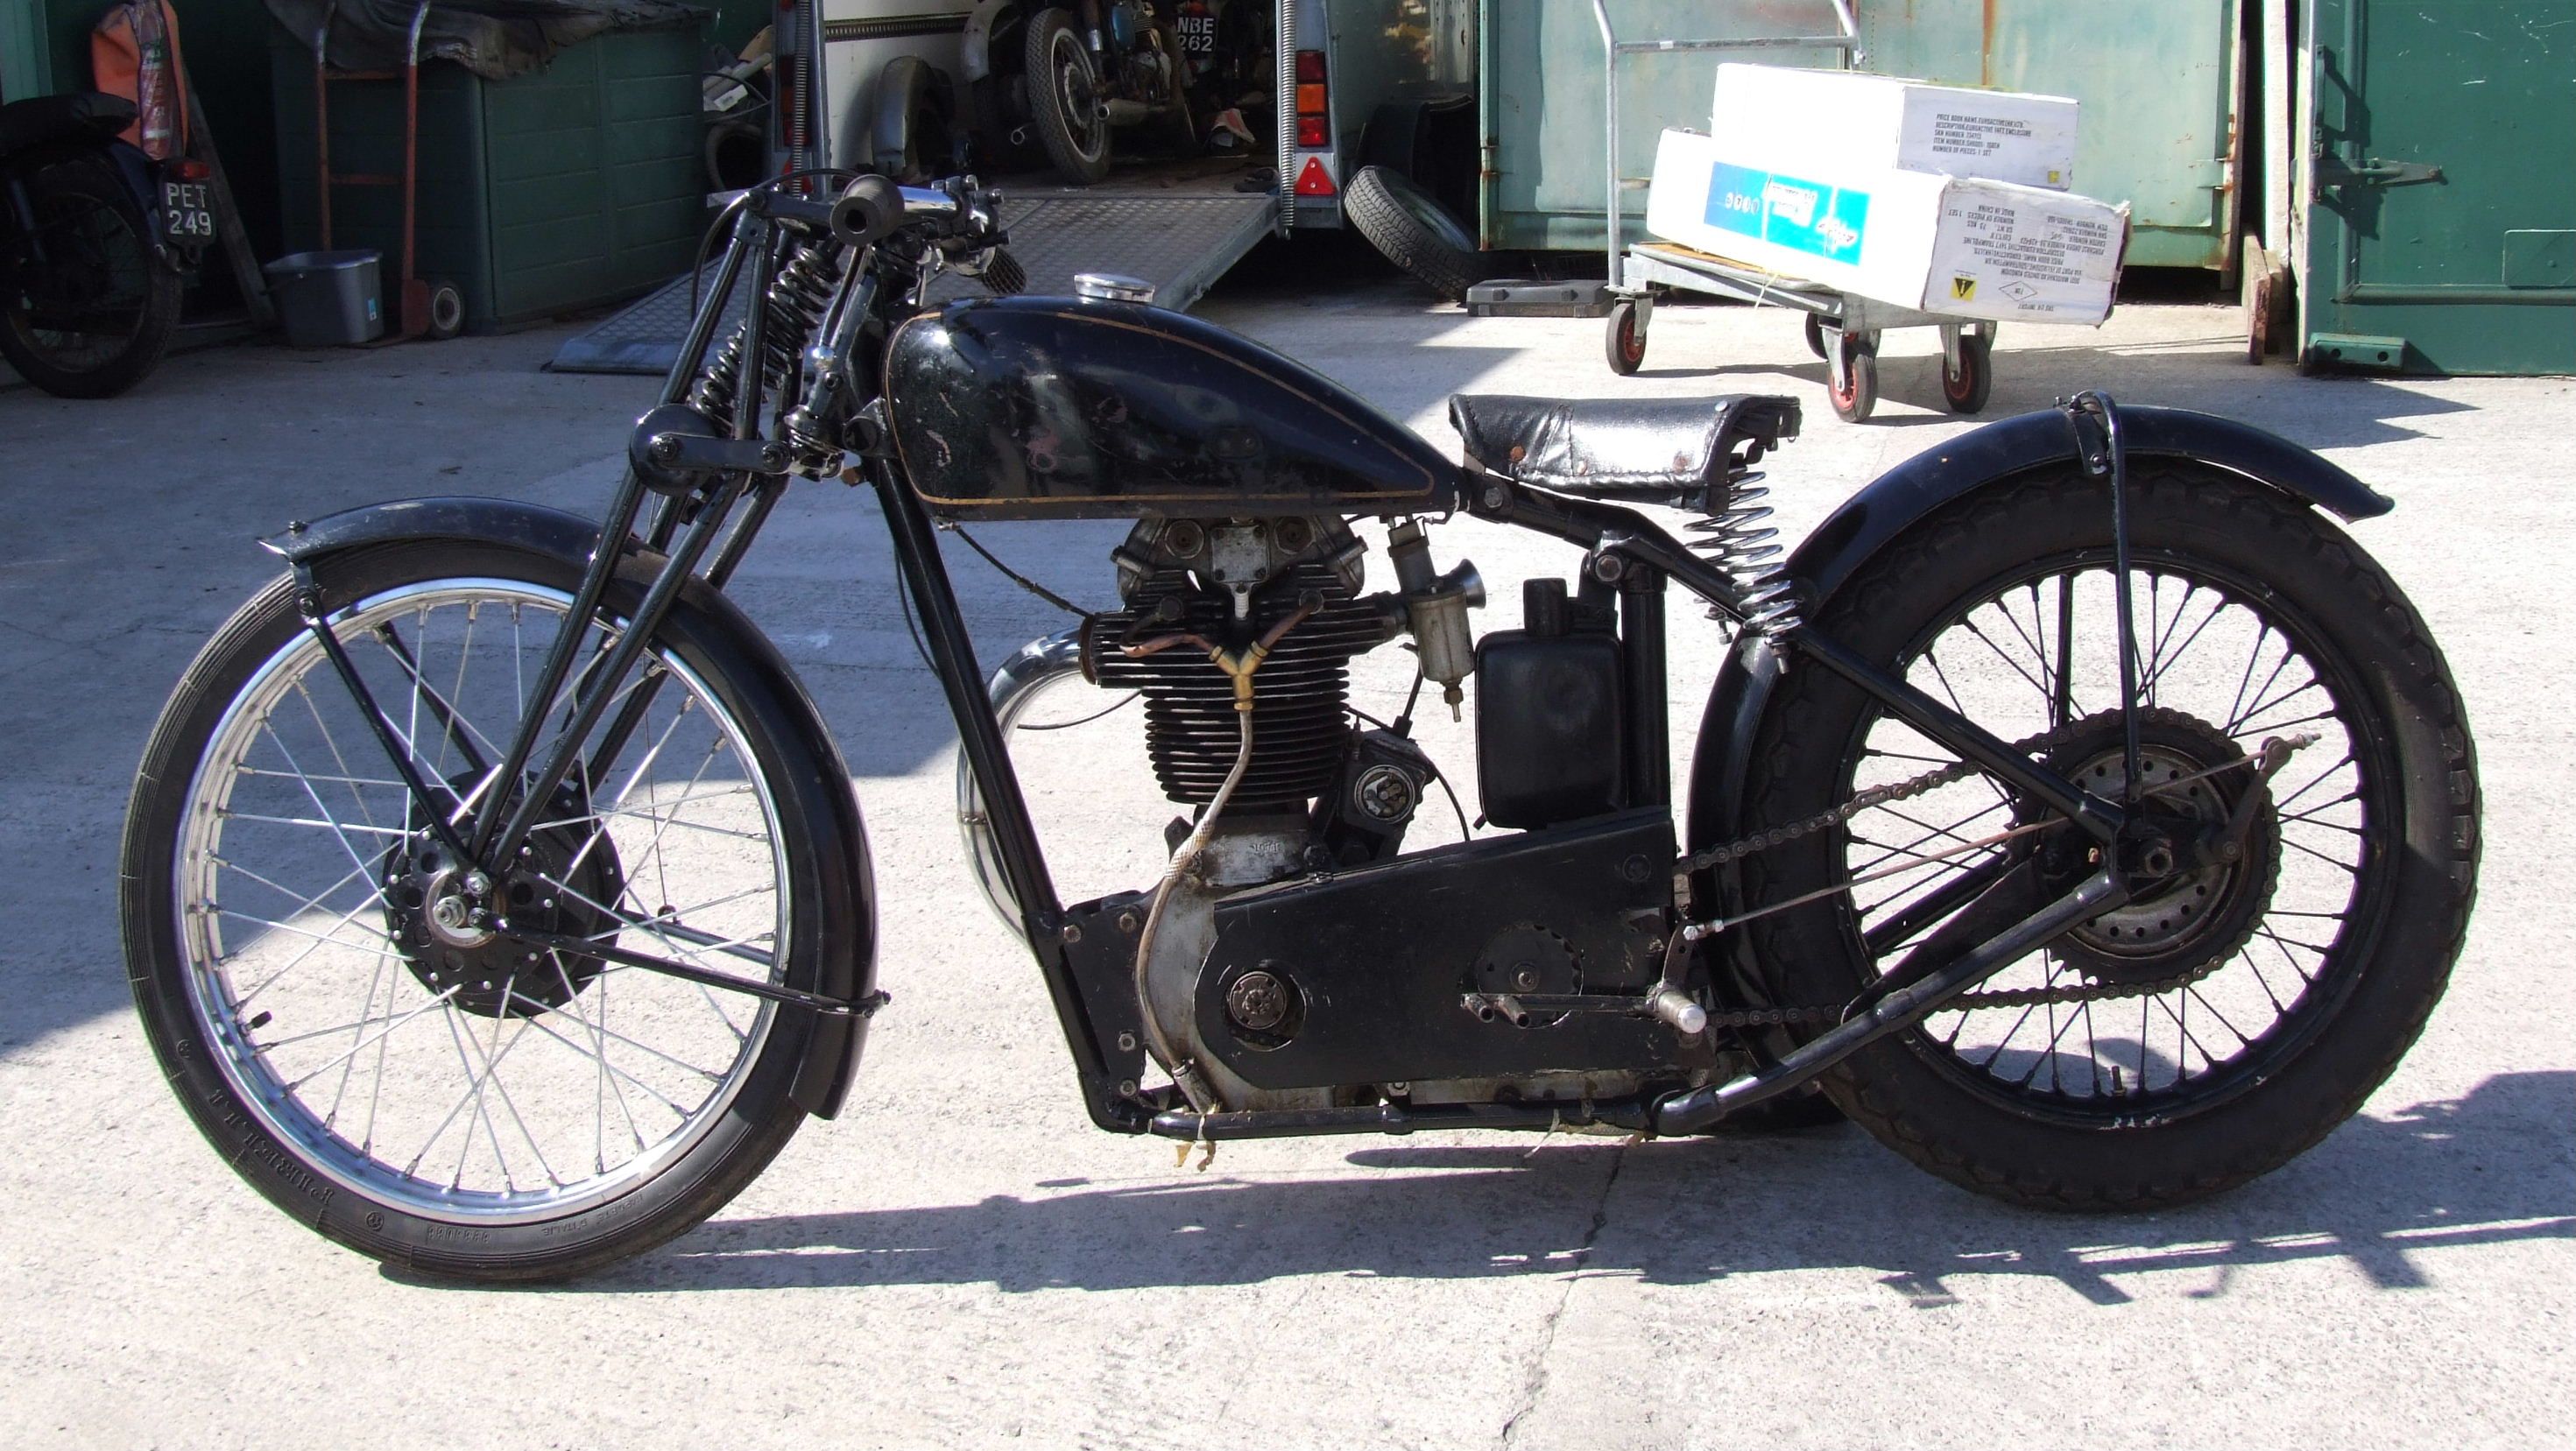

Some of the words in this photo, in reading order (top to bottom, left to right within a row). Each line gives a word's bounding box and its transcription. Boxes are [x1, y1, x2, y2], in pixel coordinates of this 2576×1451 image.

[1177, 17, 1214, 34] NBE
[1178, 35, 1213, 52] 262
[166, 182, 206, 208] PET
[2001, 208, 2015, 217] MADE
[169, 209, 212, 236] 249
[1994, 215, 2015, 224] NUMBER
[1963, 236, 1994, 248] TRAMPOLINE
[2066, 243, 2081, 252] ORDER
[2082, 246, 2105, 255] PURCHASE
[2050, 257, 2064, 266] PRICE
[208, 1088, 335, 1206] PIRELLI
